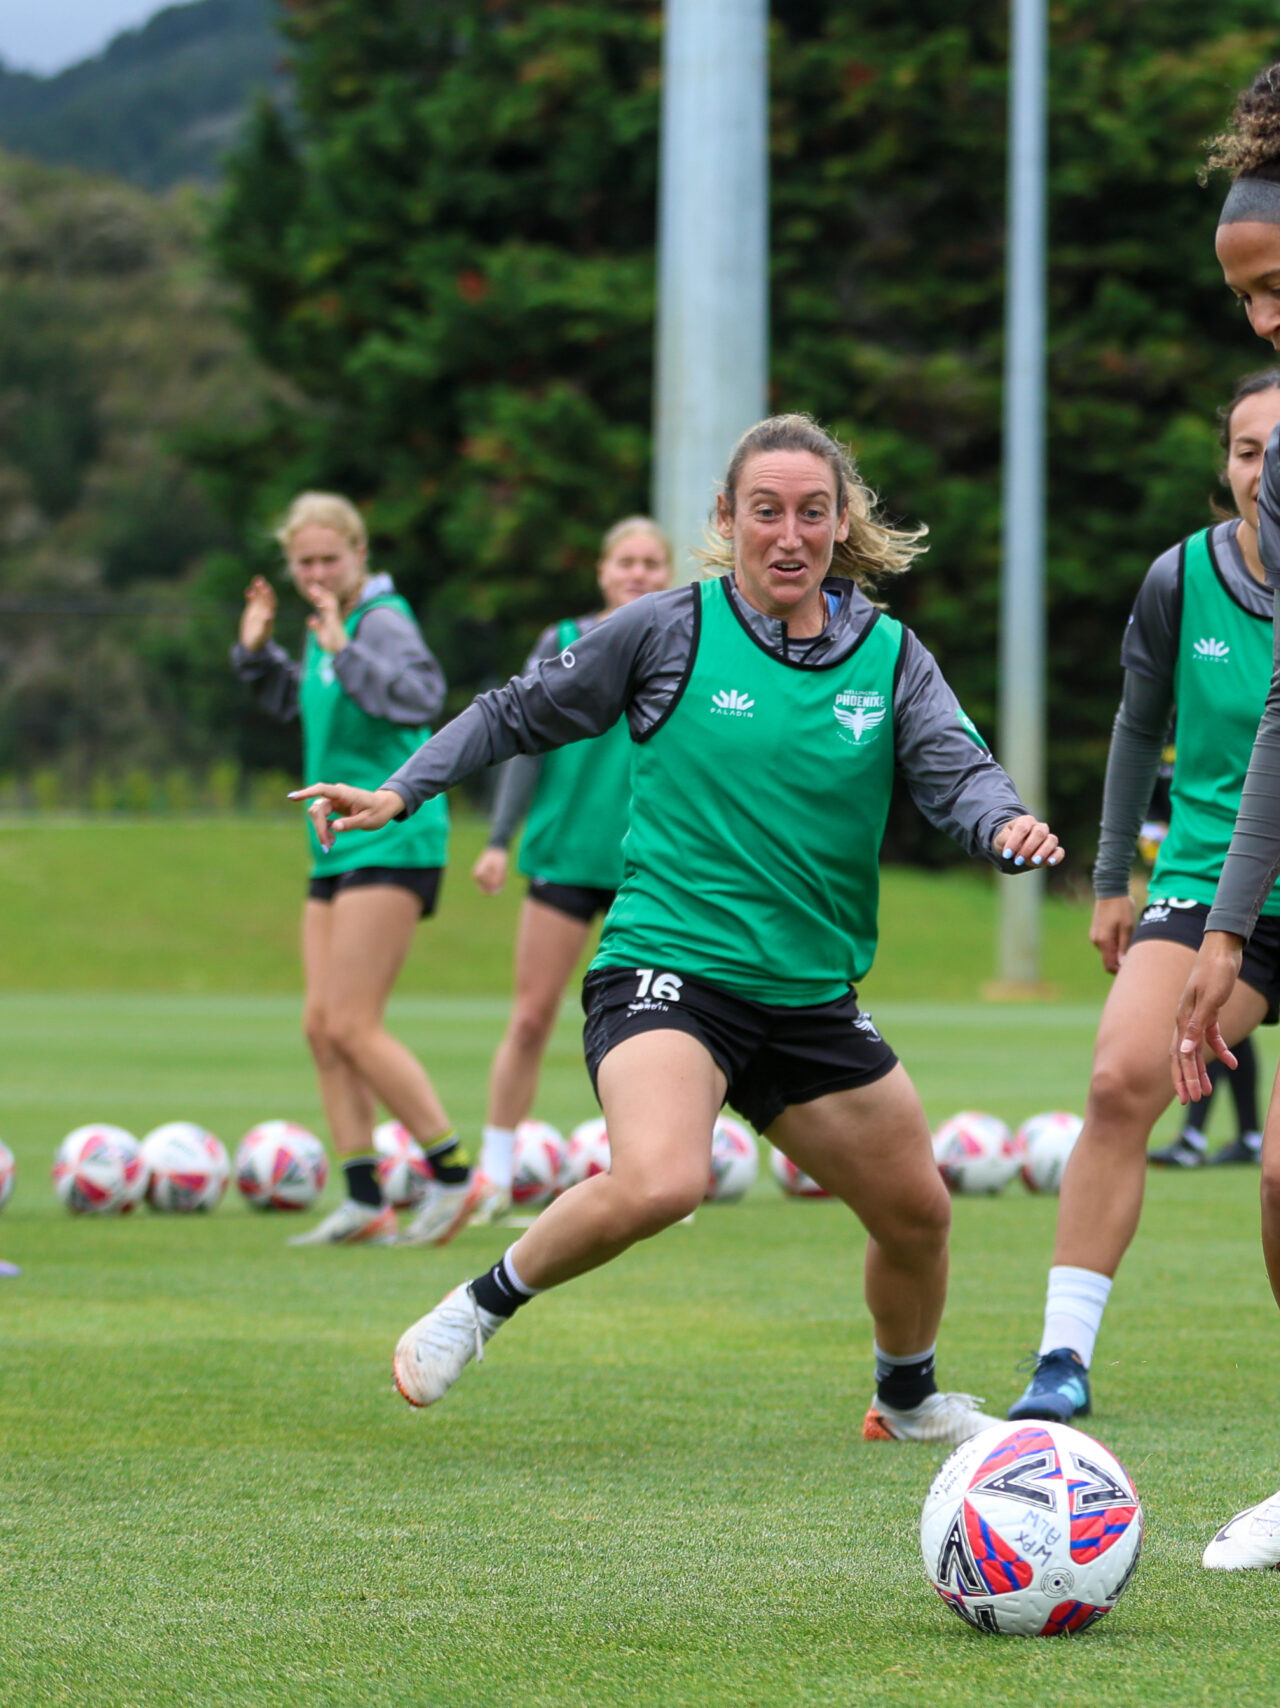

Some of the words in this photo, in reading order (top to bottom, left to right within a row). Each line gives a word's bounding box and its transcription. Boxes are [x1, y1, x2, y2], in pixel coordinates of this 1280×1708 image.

[710, 707, 754, 718] PALADIN
[835, 693, 880, 708] PHOENIX
[635, 969, 684, 1002] 16
[1013, 1530, 1053, 1567] WPX
